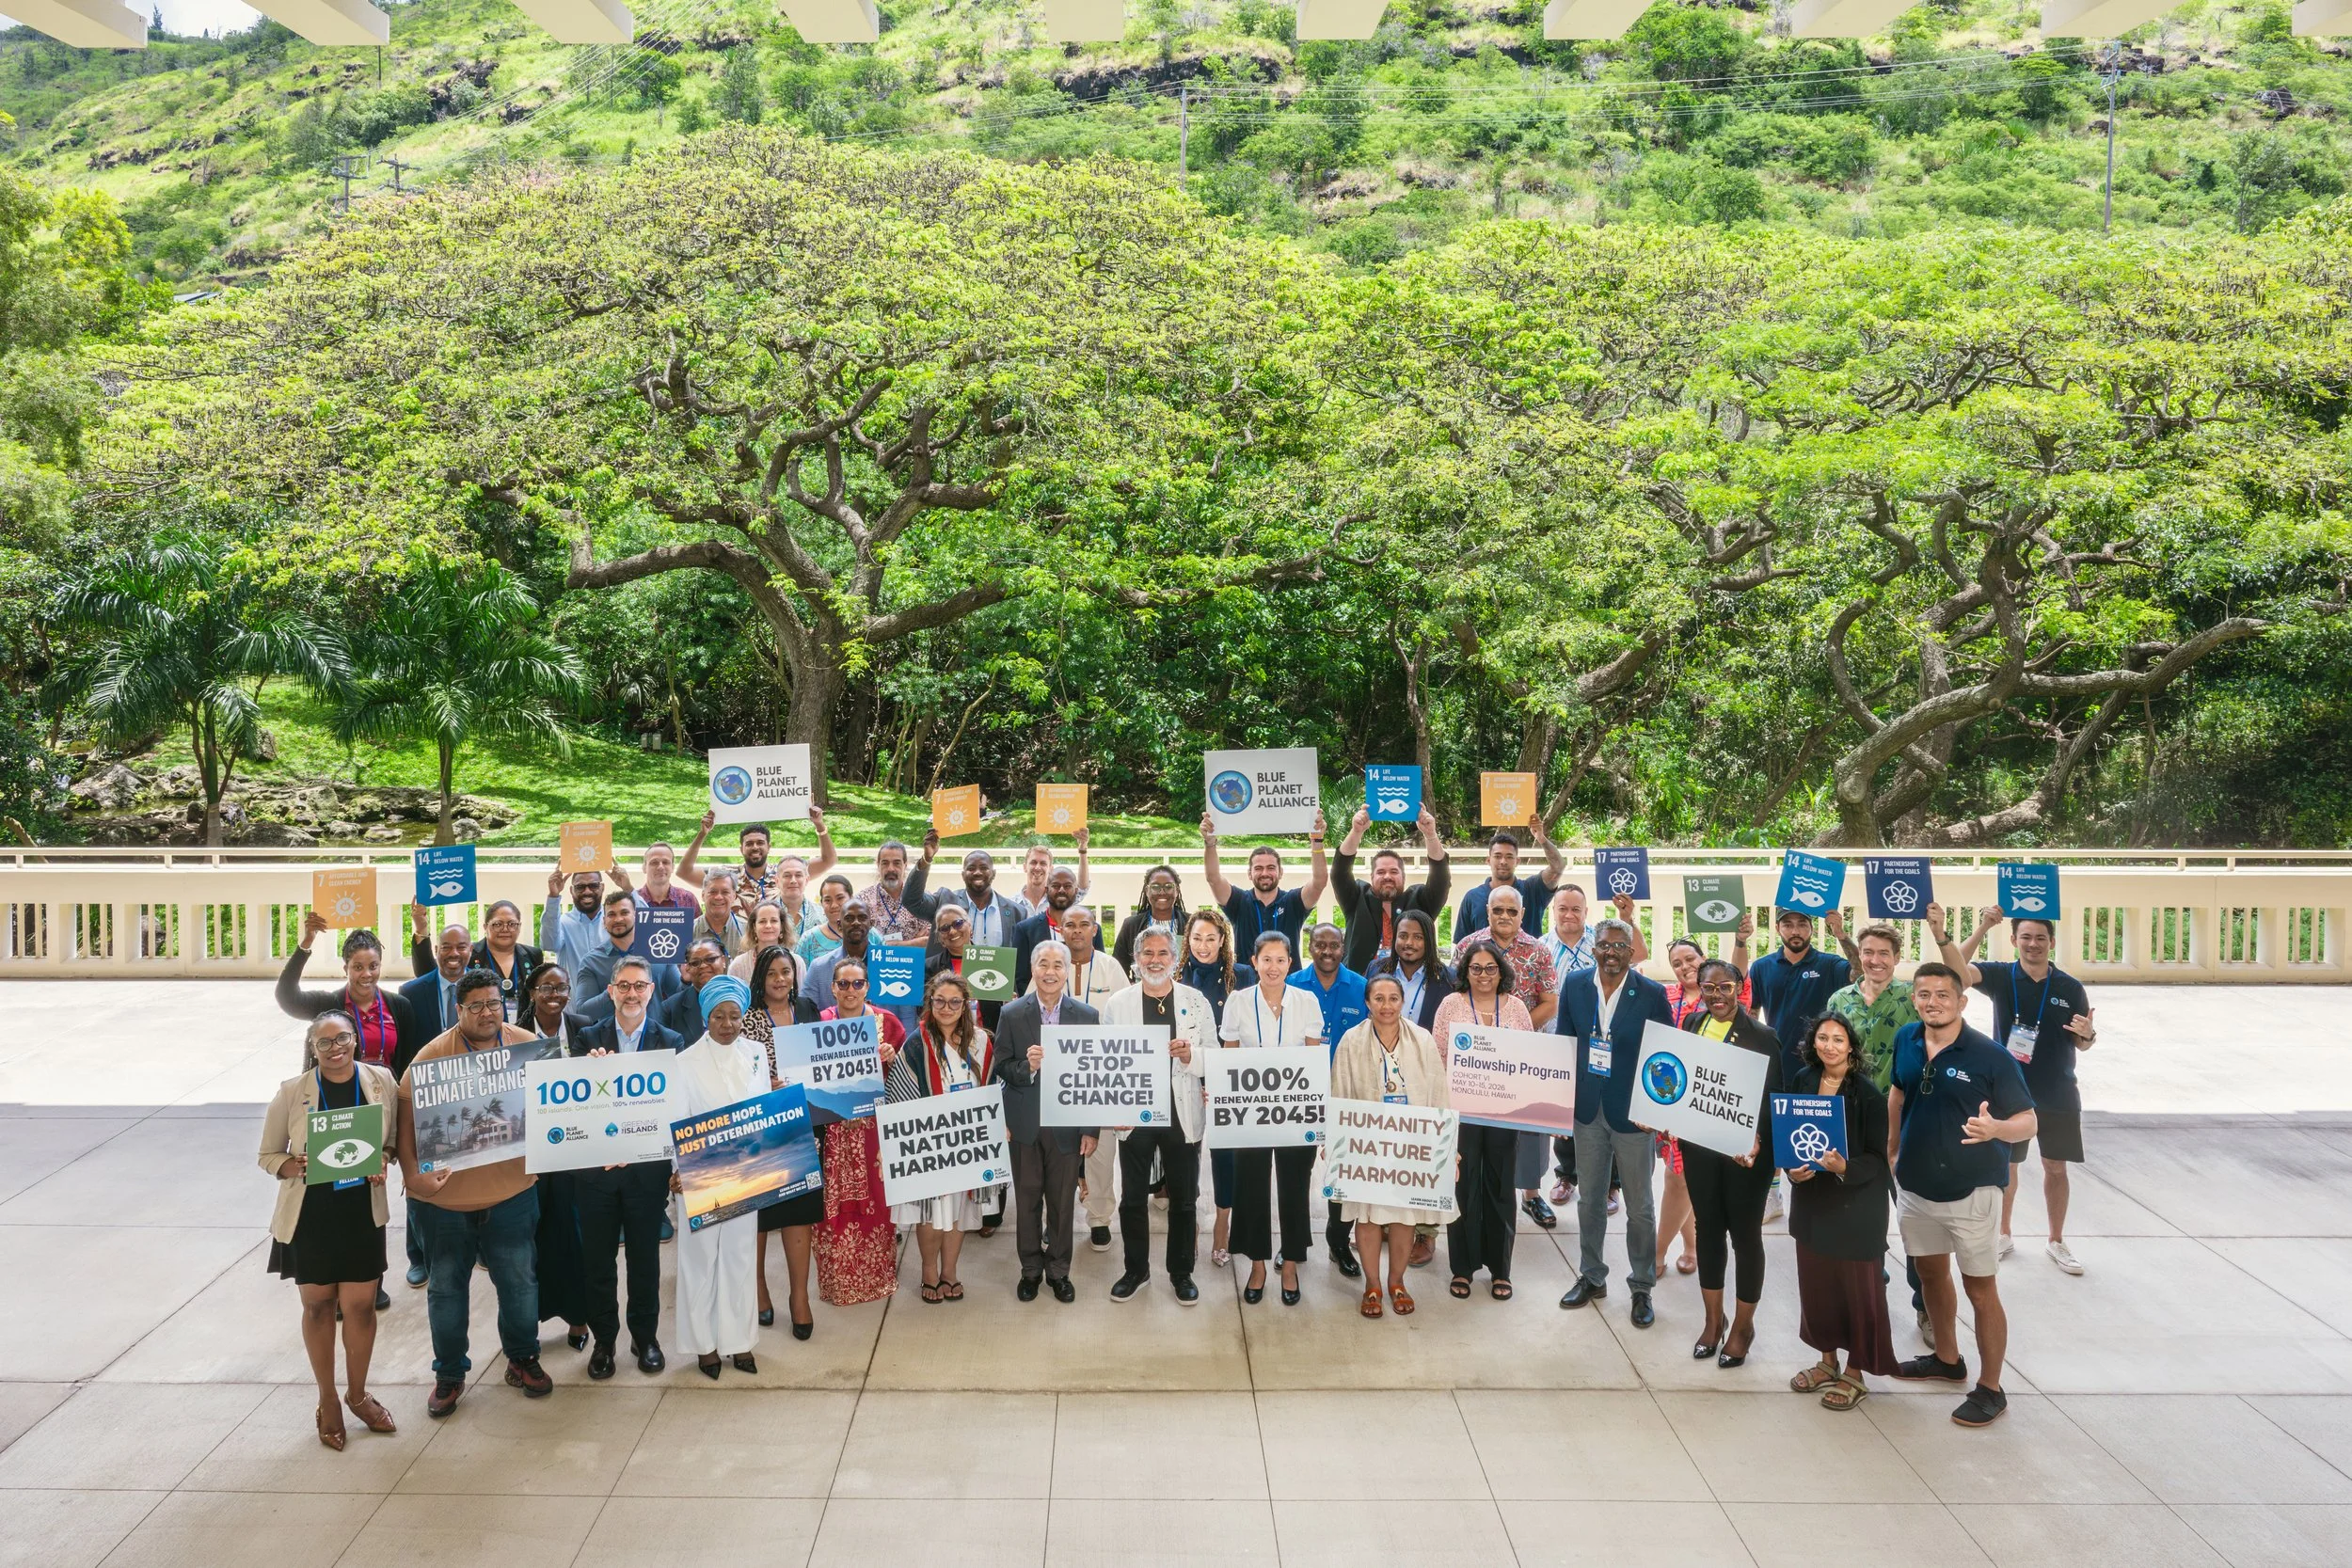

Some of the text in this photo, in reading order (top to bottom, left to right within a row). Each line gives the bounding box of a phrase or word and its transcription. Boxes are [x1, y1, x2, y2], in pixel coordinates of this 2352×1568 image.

[756, 766, 782, 776] BLUE
[1257, 771, 1285, 783] BLUE
[1368, 768, 1379, 781] 14
[756, 776, 797, 787] PLANET
[1485, 777, 1490, 790] 7
[756, 787, 808, 799] ALLIANCE
[1258, 784, 1302, 795] PLANET
[1258, 797, 1316, 808] ALLIANCE
[418, 852, 430, 865] 14
[1597, 852, 1606, 863] 17
[1788, 854, 1800, 868] 14
[1867, 861, 1879, 874] 17
[2000, 866, 2012, 879] 14
[318, 874, 325, 887] 7
[1687, 879, 1699, 892] 13
[638, 911, 649, 923] 17
[870, 949, 882, 961] 14
[965, 948, 977, 960] 13
[811, 1022, 868, 1049] 100%
[1057, 1039, 1154, 1053] WE WILL
[811, 1046, 875, 1063] RENEWABLE ENERGY
[412, 1049, 511, 1085] WE WILL STOP
[813, 1057, 879, 1083] BY 2045!
[1077, 1055, 1134, 1071] STOP
[1454, 1053, 1570, 1080] Fellowship Program
[1059, 1073, 1152, 1088] CLIMATE
[1227, 1067, 1310, 1092] 100%
[1453, 1071, 1481, 1081] COHORT
[1694, 1066, 1727, 1086] BLUE
[415, 1069, 525, 1109] CLIMATE CHANG
[1452, 1086, 1490, 1097] HONOLULU,
[1692, 1081, 1742, 1107] PLANET
[1057, 1090, 1153, 1105] CHANGE!
[1215, 1094, 1324, 1104] RENEWABLE ENERGY
[1793, 1100, 1832, 1108] PARTNERSHIPS
[1689, 1097, 1754, 1129] ALLIANCE
[1773, 1099, 1788, 1115] 17
[331, 1113, 354, 1121] CLIMATE
[675, 1104, 763, 1141] NO MORE HOPE
[882, 1103, 999, 1140] HUMANITY
[1214, 1105, 1326, 1126] BY 2045!
[311, 1117, 327, 1132] 13
[622, 1119, 658, 1128] GREENING
[625, 1125, 658, 1134] ISLANDS
[1339, 1111, 1445, 1136] HUMANITY
[678, 1106, 803, 1156] JUST DETERMINATION
[899, 1125, 989, 1157] NATURE
[1350, 1138, 1432, 1162] NATURE
[889, 1142, 1003, 1180] HARMONY
[1339, 1164, 1439, 1189] HARMONY
